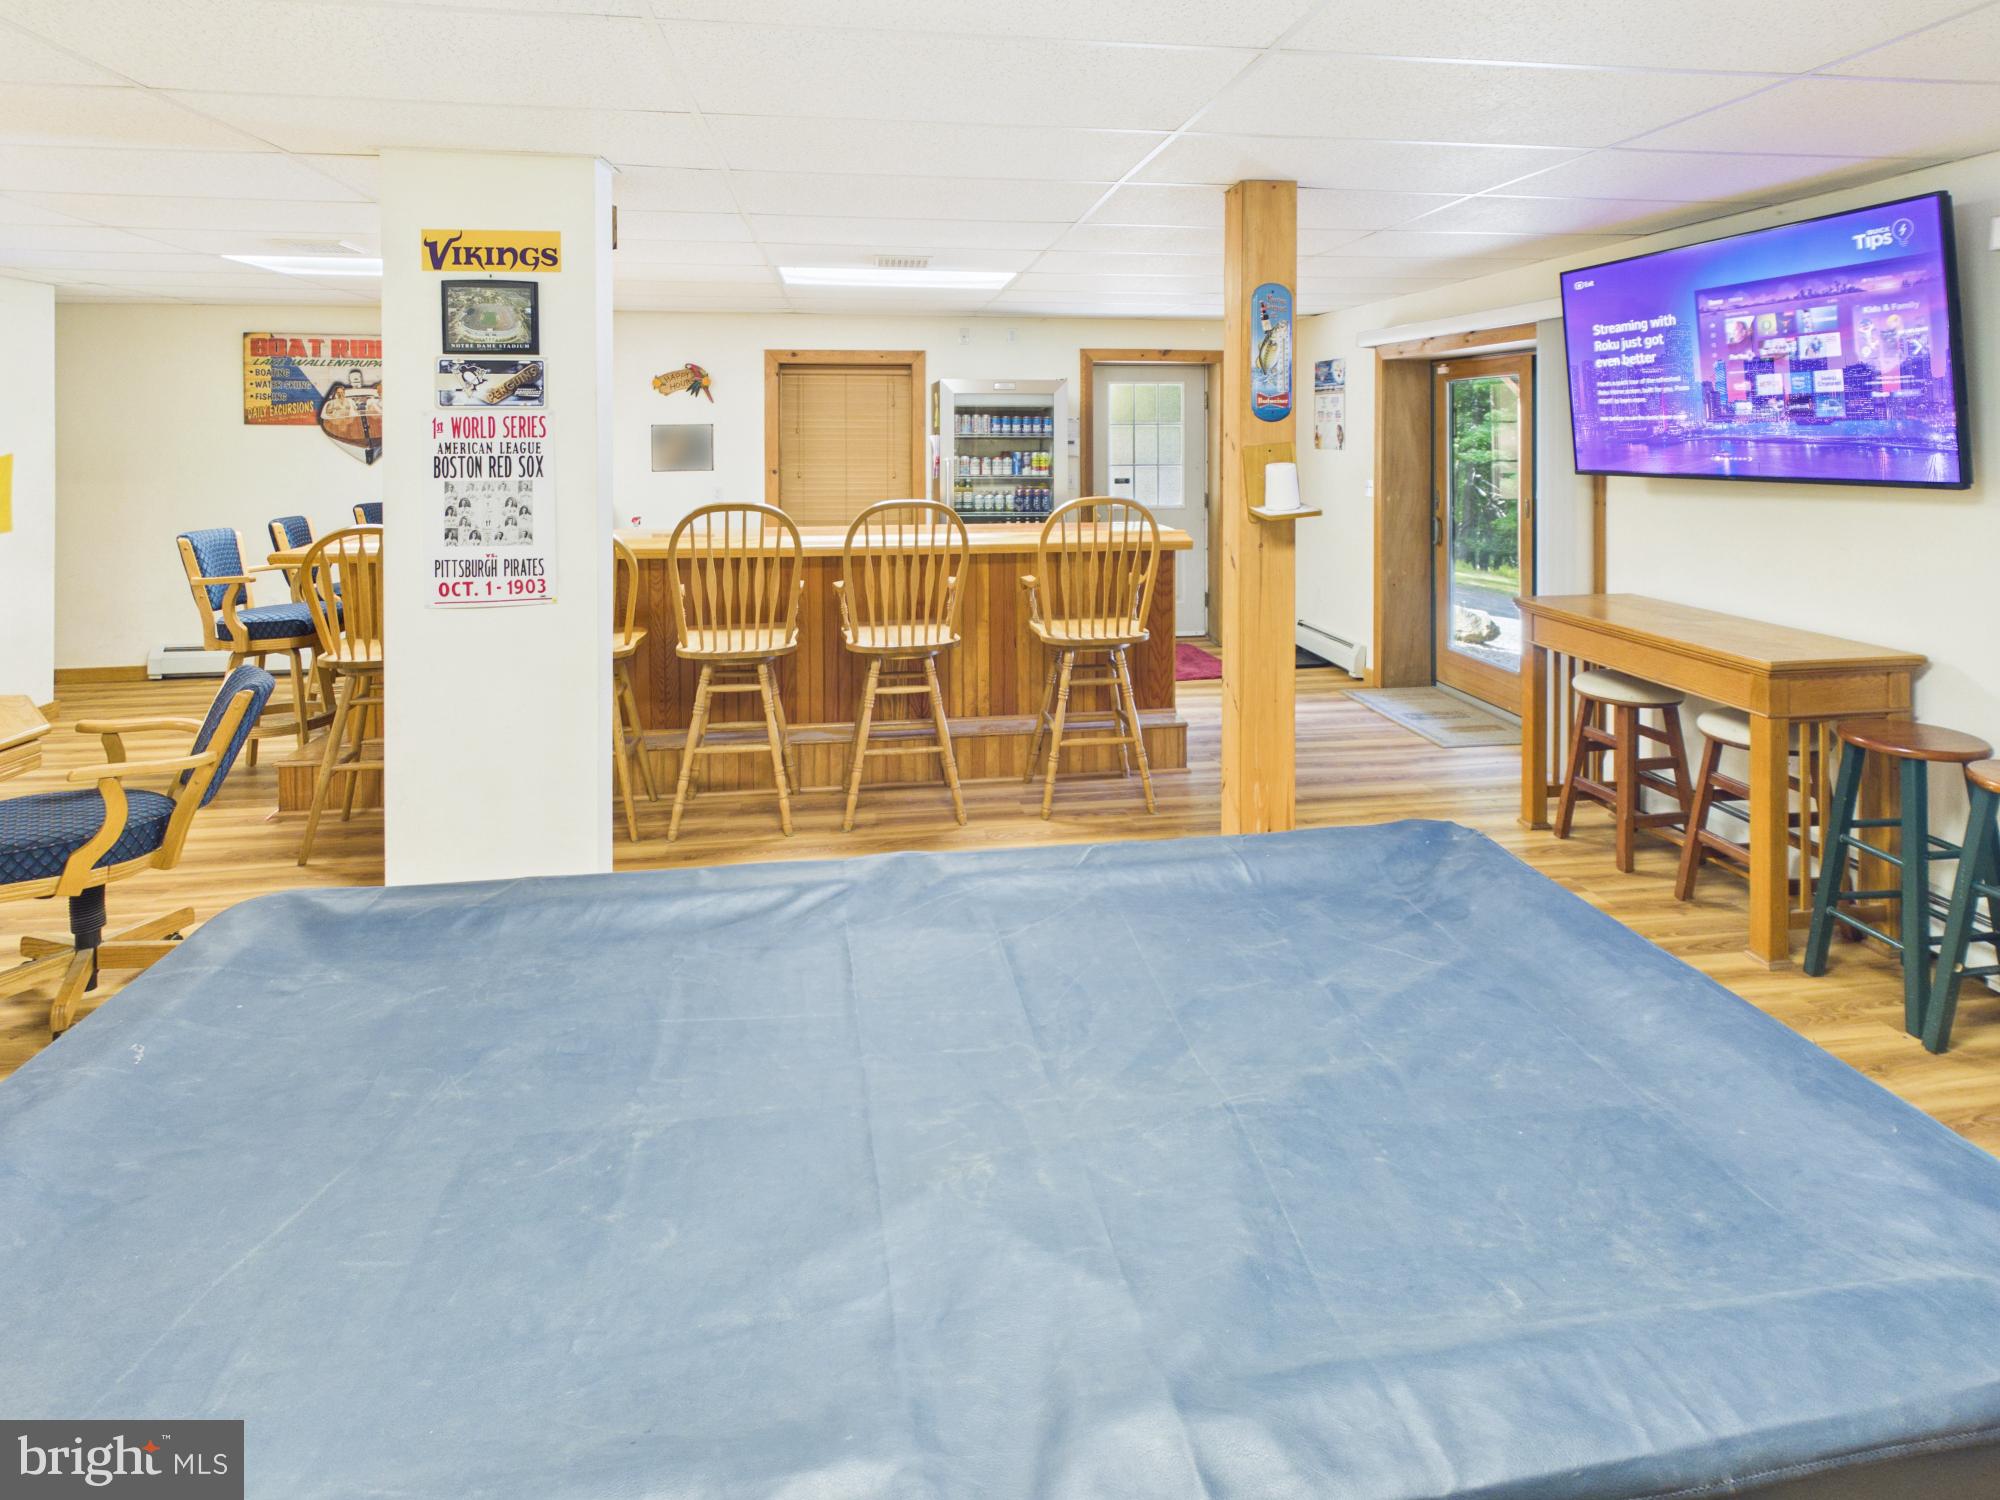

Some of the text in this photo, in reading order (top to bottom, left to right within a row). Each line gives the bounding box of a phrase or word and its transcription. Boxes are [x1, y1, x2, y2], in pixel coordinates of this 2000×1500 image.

[423, 230, 559, 271] VIKINGS
[1851, 233, 1893, 250] Tips
[1592, 314, 1677, 336] Streaming with
[250, 338, 325, 358] BOAT
[1593, 334, 1664, 352] Roku just got
[253, 358, 287, 366] LAKE
[1595, 354, 1657, 368] even better
[255, 368, 290, 377] BOATING
[664, 372, 690, 383] HAPPY
[255, 380, 312, 390] WATER SKIING
[487, 366, 538, 402] PENGUINS
[670, 379, 691, 389] HOUR
[255, 393, 288, 401] FISHING
[248, 407, 267, 420] DAILY
[270, 401, 315, 417] EXCURSIONS
[451, 415, 496, 439] WORLD
[502, 415, 546, 438] SERIES
[437, 441, 541, 455] AMERICAN LEAGUE
[433, 455, 544, 478] BOSTON RED SOX
[434, 558, 545, 578] PITTSBURGH PIRATES
[438, 581, 479, 597] OCT.
[507, 578, 546, 595] 1903
